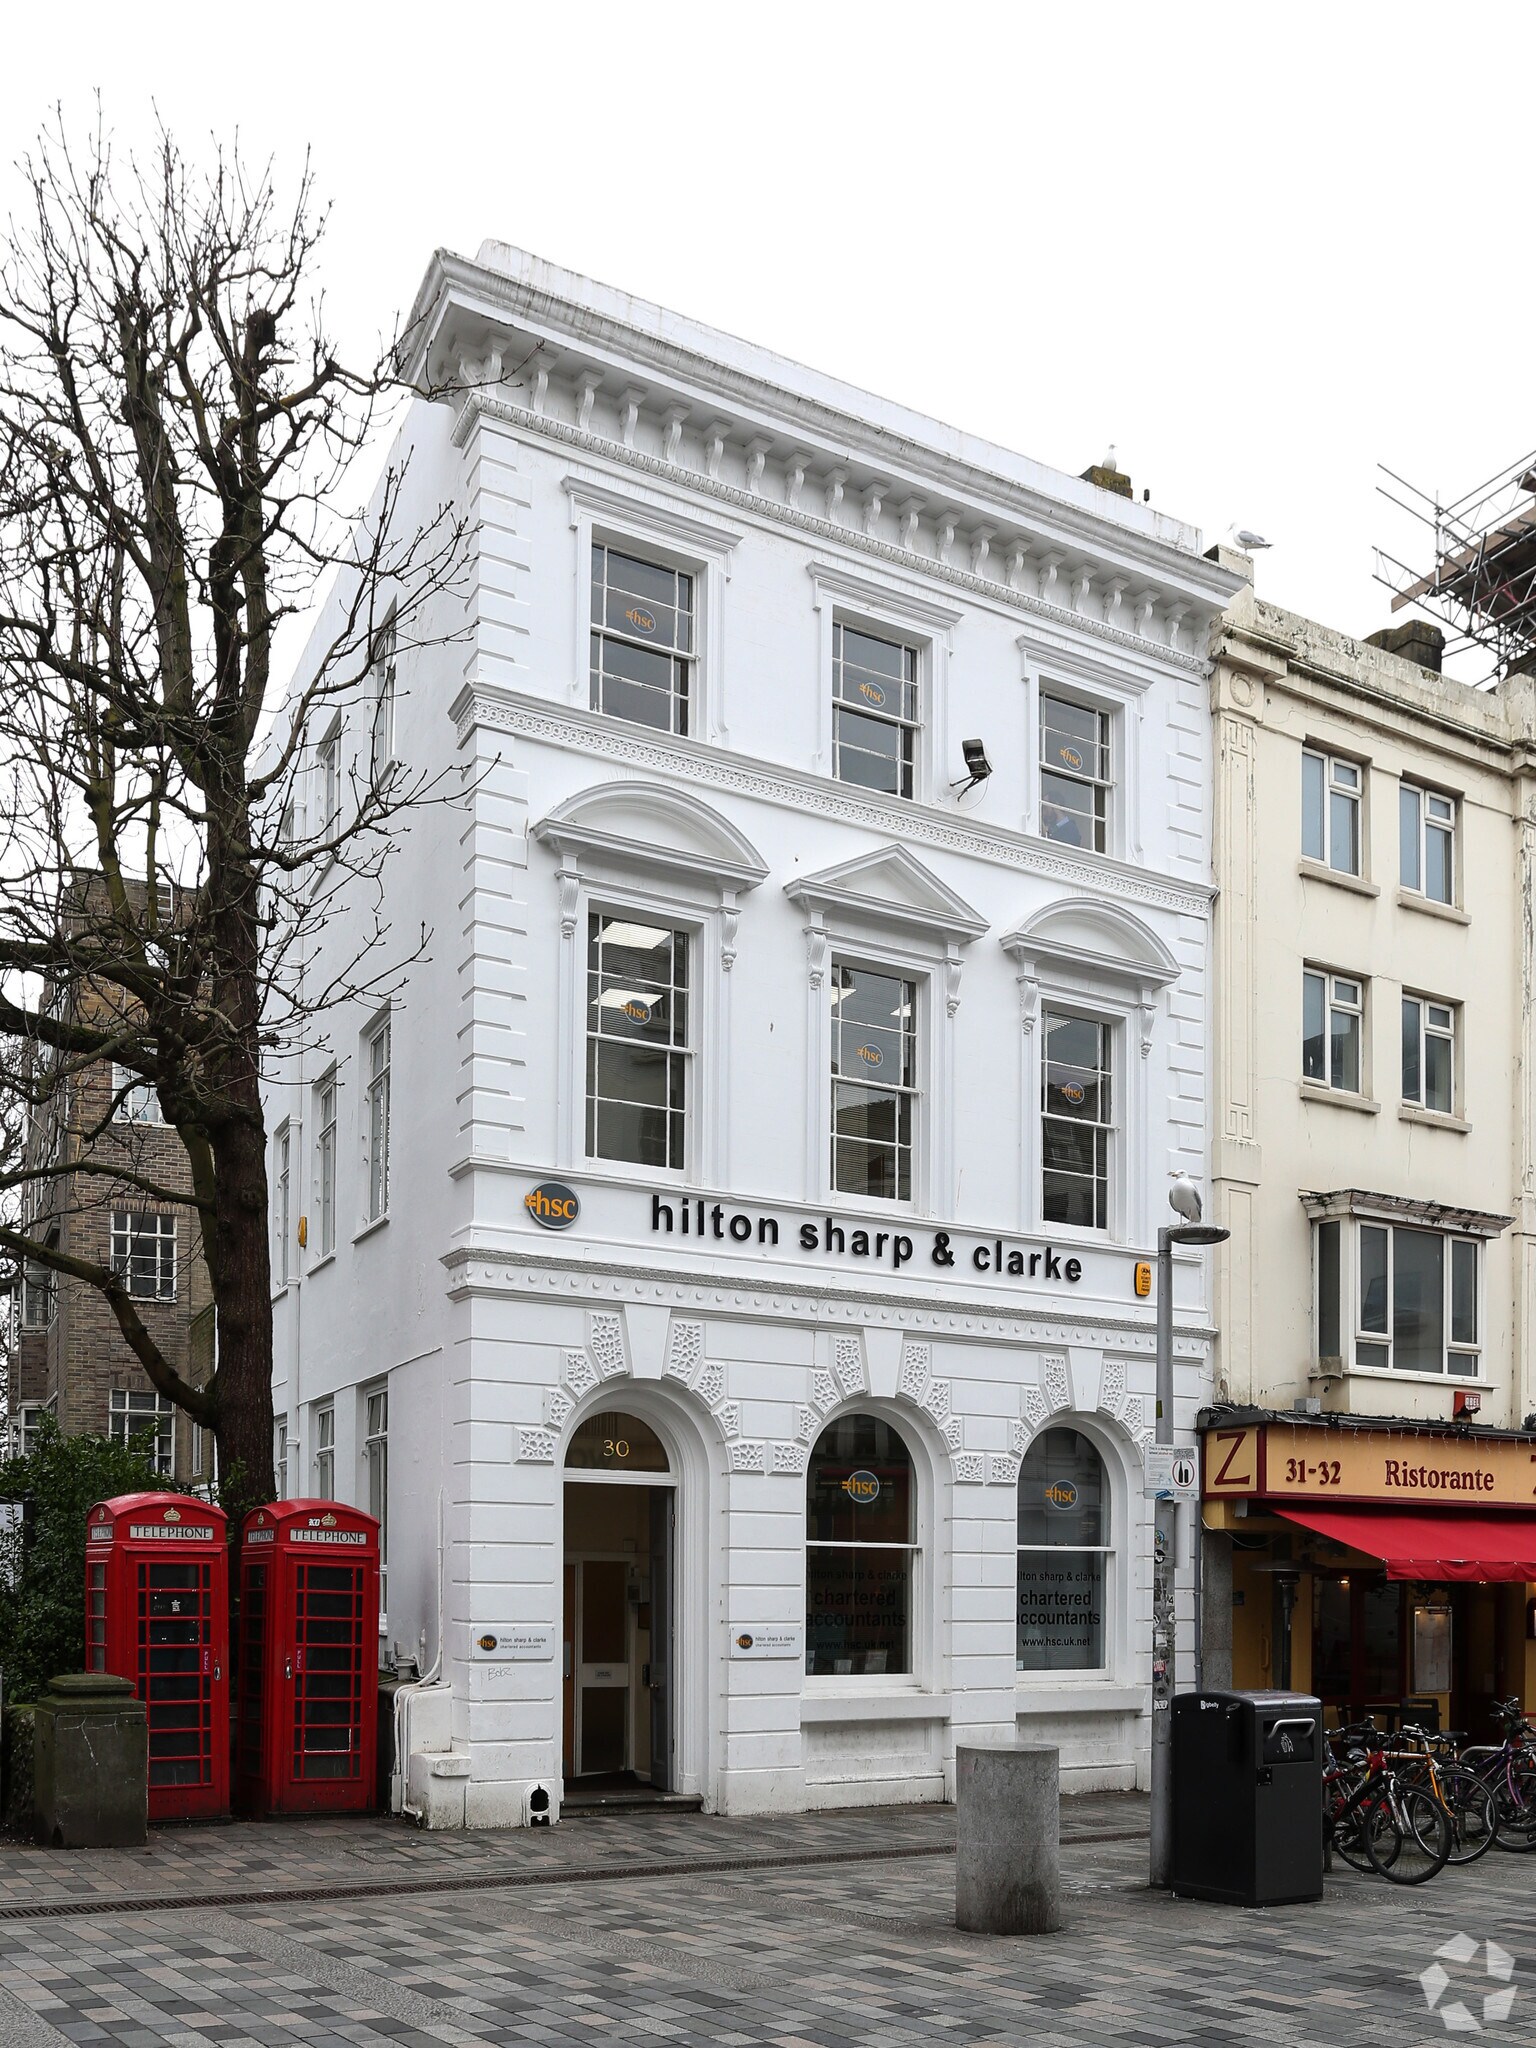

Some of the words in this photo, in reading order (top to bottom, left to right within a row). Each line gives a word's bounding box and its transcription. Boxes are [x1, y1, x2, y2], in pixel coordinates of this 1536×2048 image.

[633, 609, 654, 629] hsc
[865, 685, 883, 704] hsc
[1065, 750, 1081, 767] hsc
[633, 1003, 653, 1021] hsc
[863, 1047, 882, 1064] hsc
[1066, 1086, 1083, 1100] hsc
[536, 1190, 577, 1219] hsc
[651, 1193, 780, 1246] hilton
[799, 1216, 913, 1268] sharp
[931, 1231, 955, 1267] &
[972, 1240, 1083, 1283] clarke
[602, 1439, 631, 1458] 30
[1213, 1430, 1251, 1486] Z
[1285, 1457, 1342, 1486] 31-32
[1384, 1460, 1495, 1492] Ristorante
[851, 1476, 877, 1496] hsc
[1054, 1486, 1076, 1503] hsc
[133, 1525, 211, 1540] TELEPHONE
[293, 1529, 364, 1544] TELEPHONE
[1039, 1572, 1065, 1584] sharp
[1066, 1572, 1073, 1583] &
[1075, 1572, 1101, 1583] clarke
[814, 1588, 897, 1606] chartered
[1020, 1590, 1092, 1606] chartered
[816, 1638, 896, 1650] www.hsc.uk.net
[1022, 1635, 1091, 1647] www.hsc.uk.net
